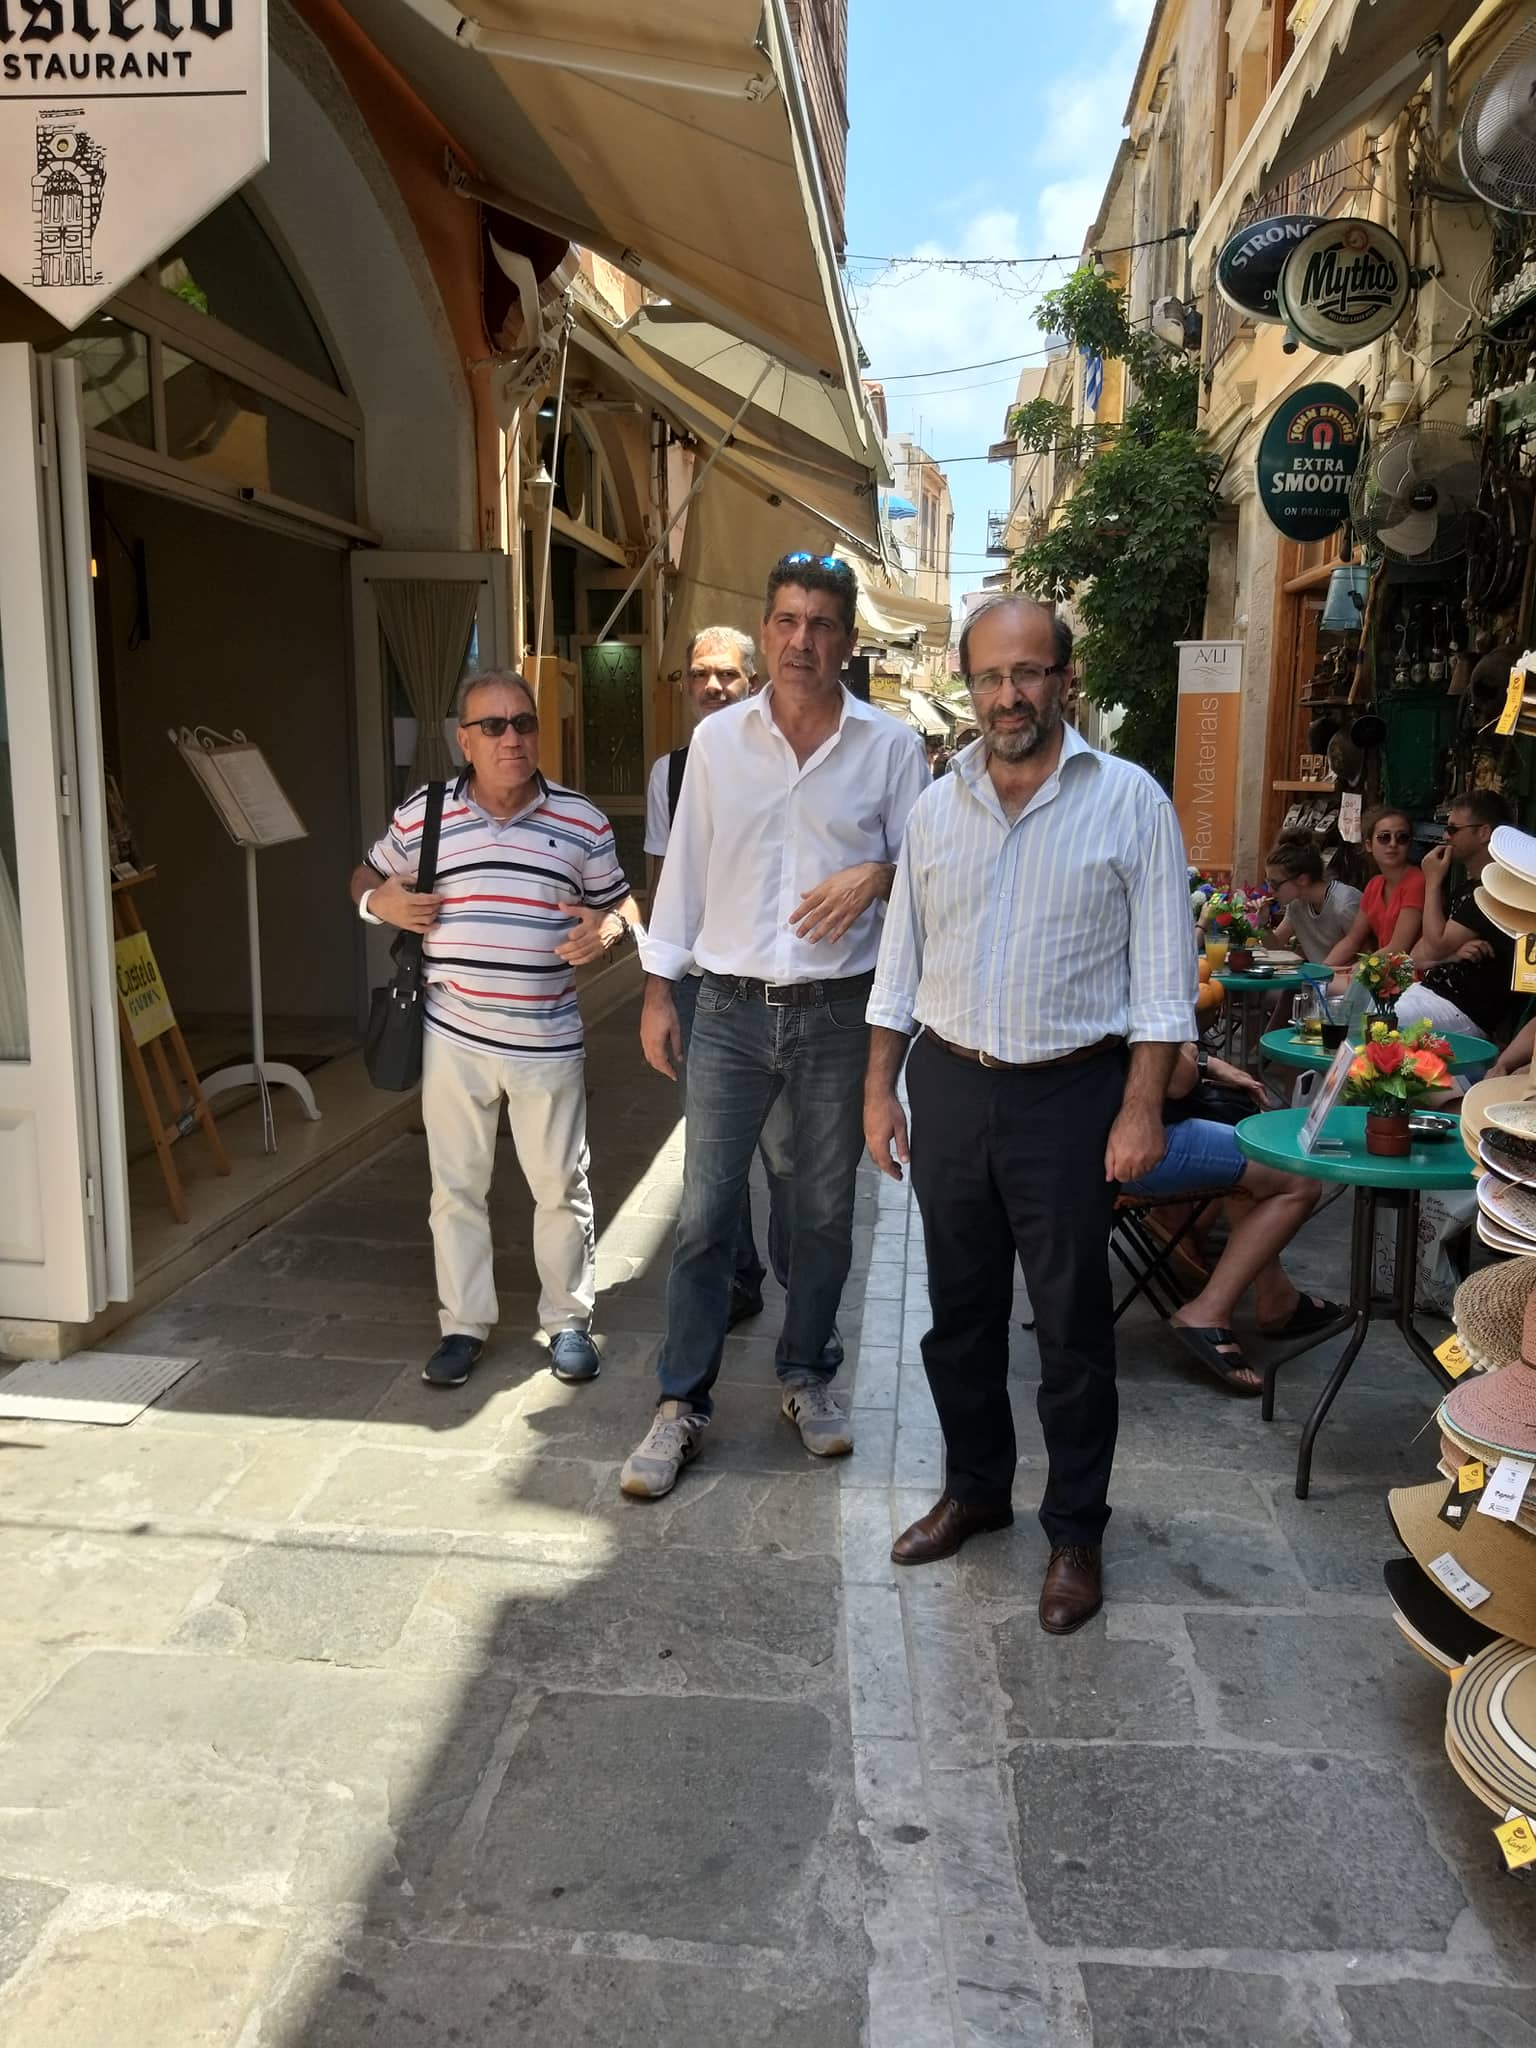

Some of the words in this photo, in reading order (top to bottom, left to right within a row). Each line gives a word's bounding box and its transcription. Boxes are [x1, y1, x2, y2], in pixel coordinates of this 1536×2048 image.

[1300, 251, 1398, 312] Mythos
[1291, 408, 1317, 440] JOHN
[1293, 458, 1344, 472] EXTRA
[1284, 507, 1297, 516] ON
[1194, 648, 1226, 664] AVLI
[1192, 697, 1219, 804] Materials
[1190, 810, 1213, 861] Raw
